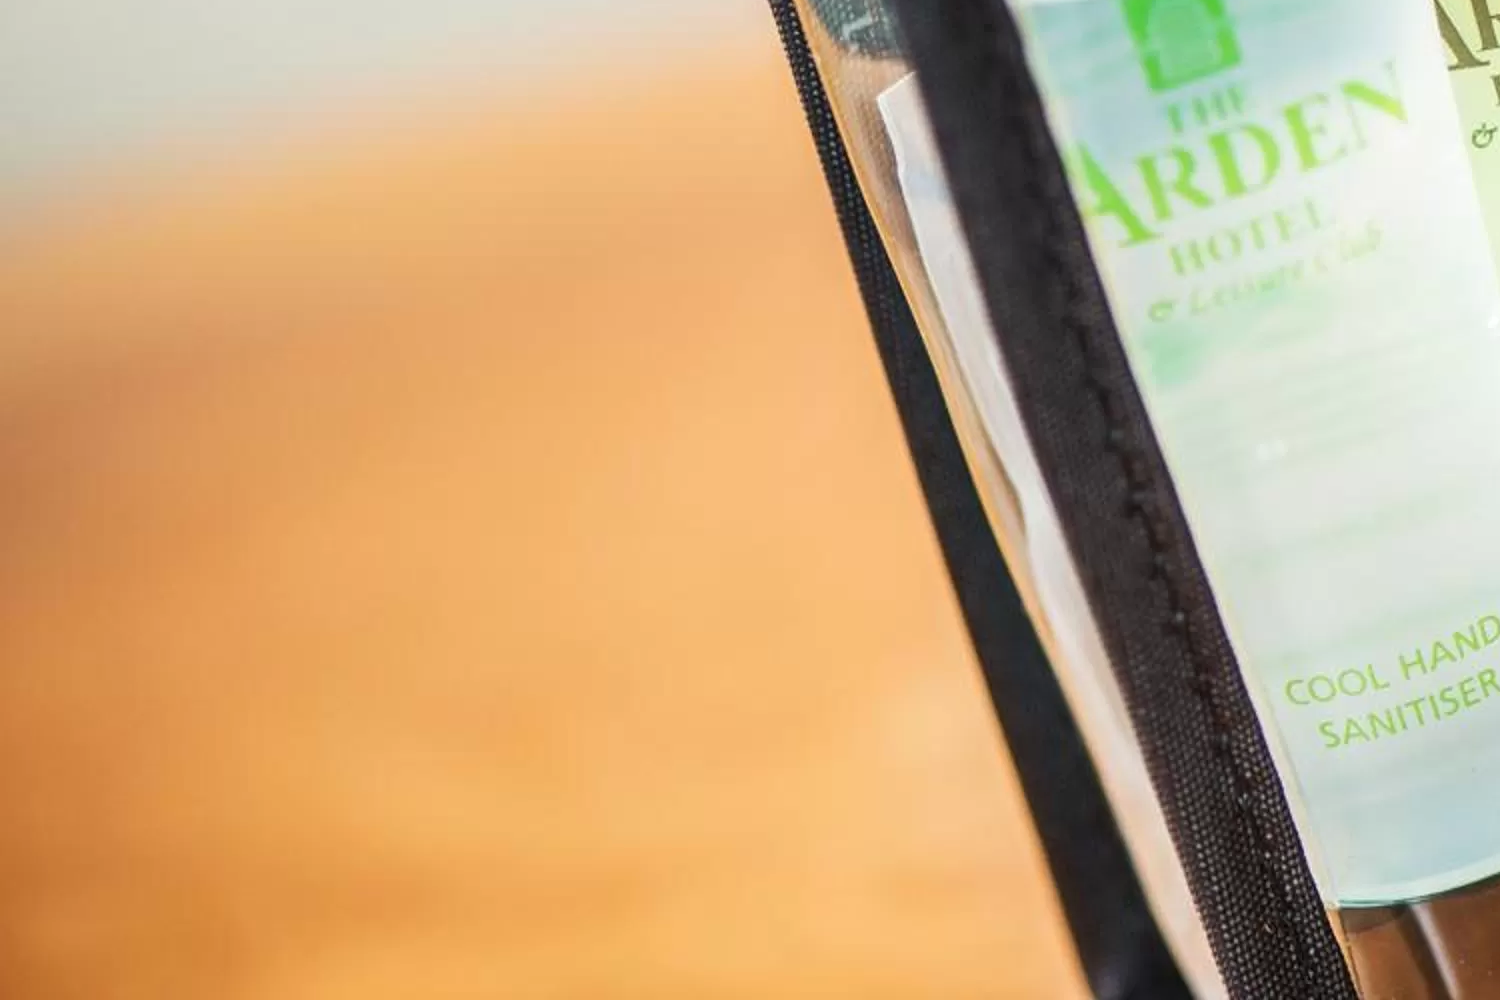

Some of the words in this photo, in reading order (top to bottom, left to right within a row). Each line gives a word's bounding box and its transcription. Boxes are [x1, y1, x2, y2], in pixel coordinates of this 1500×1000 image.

[1076, 58, 1409, 248] ARDEN
[1471, 122, 1499, 149] &
[1285, 662, 1391, 706] COOL
